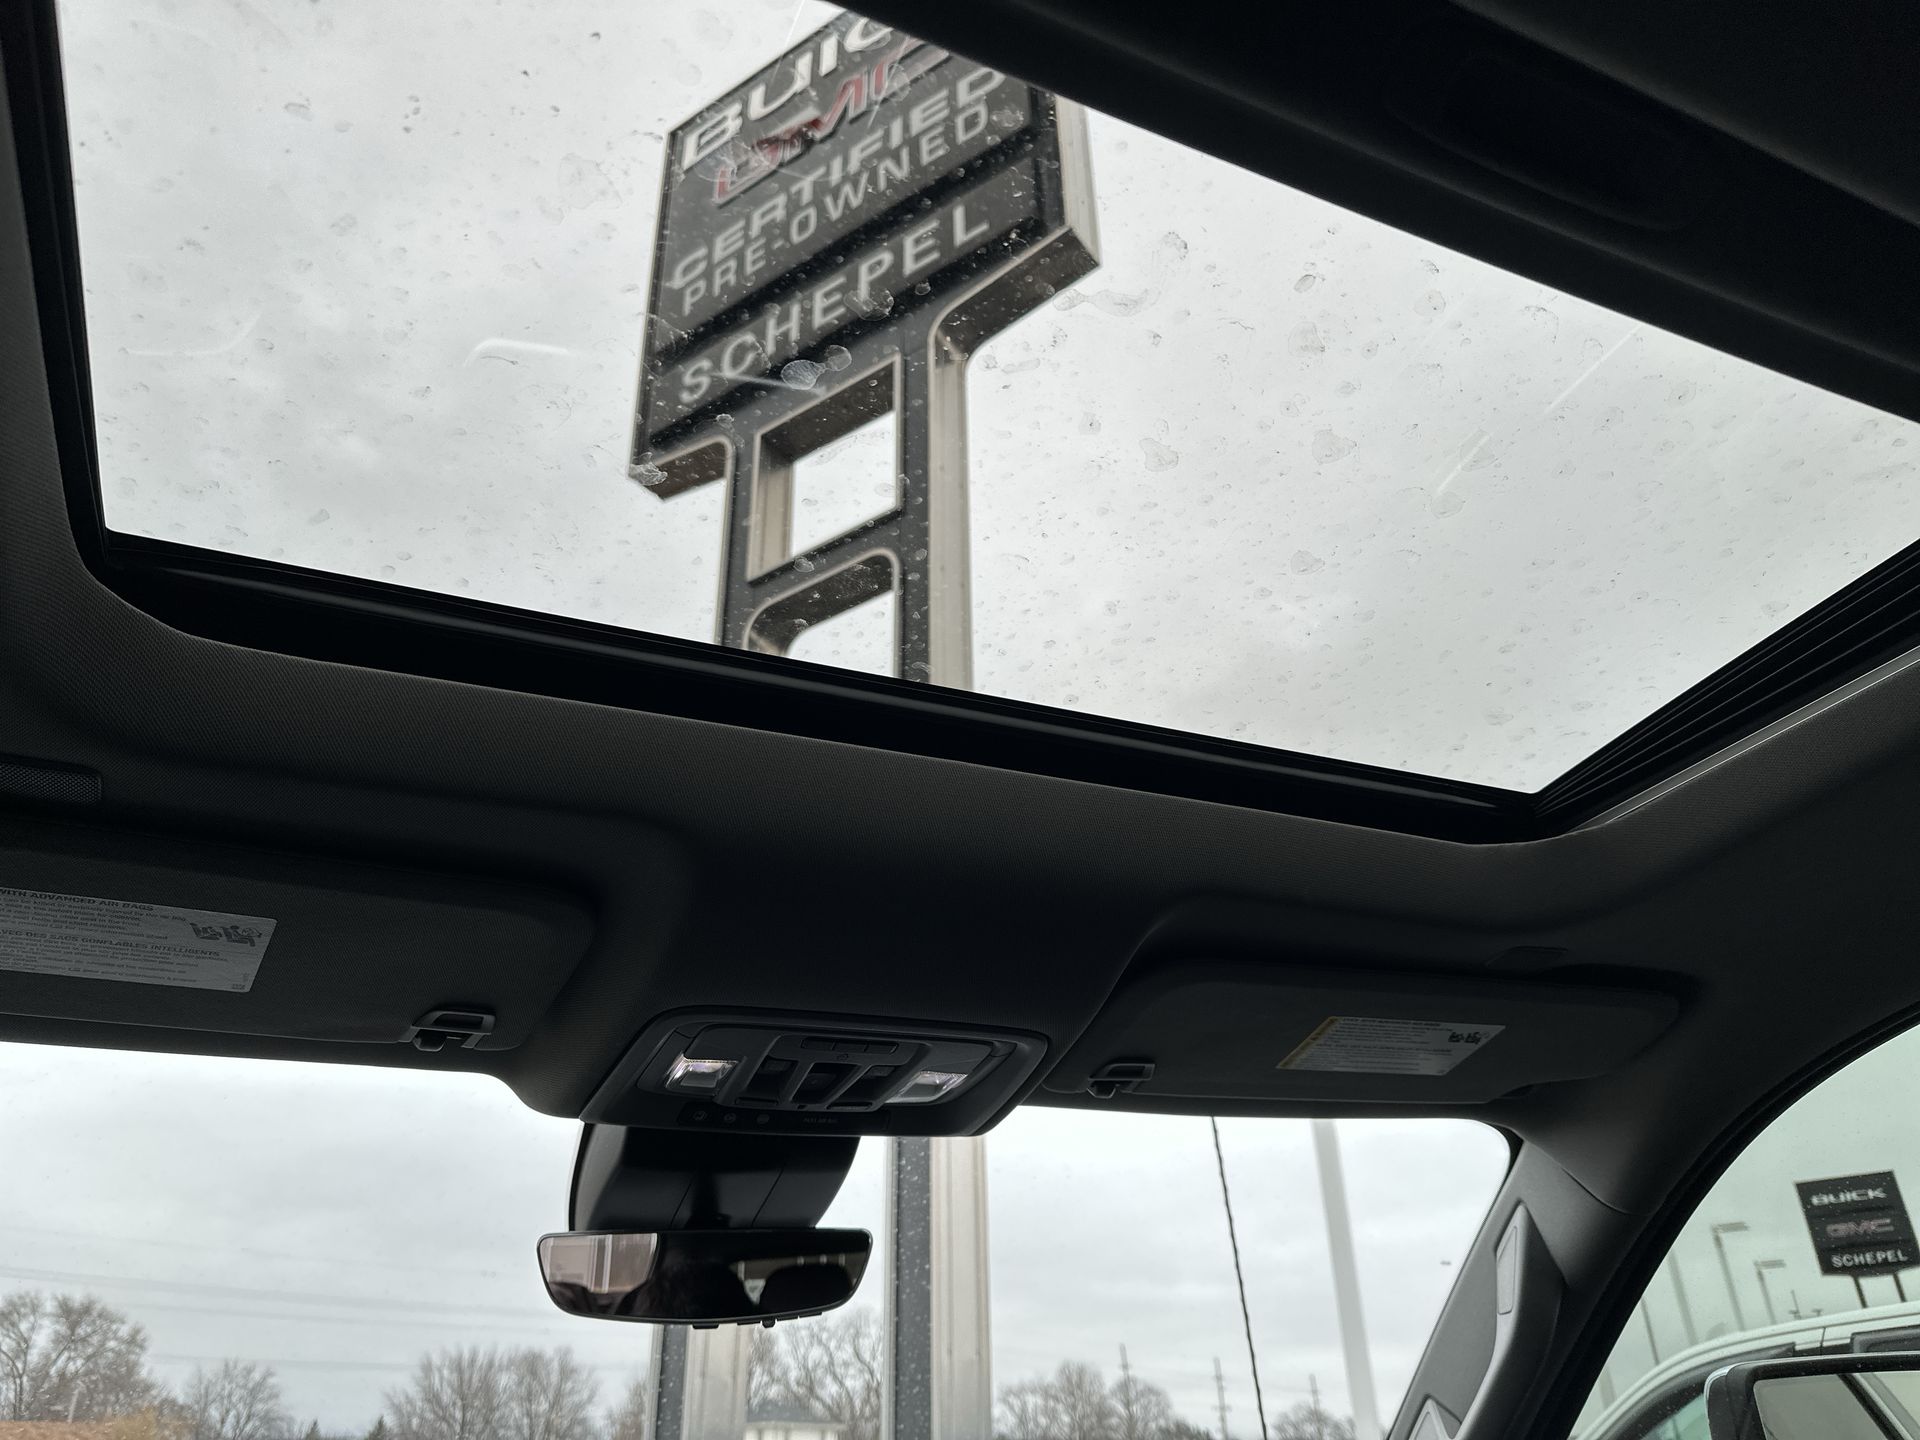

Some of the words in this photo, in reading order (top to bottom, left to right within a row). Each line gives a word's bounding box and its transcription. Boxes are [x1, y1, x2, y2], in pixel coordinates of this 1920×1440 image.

[683, 16, 894, 171] BUIC
[666, 65, 1007, 290] CERTIFIED
[682, 101, 989, 316] PRE-OWNED
[678, 204, 990, 403] SCHEPEL
[30, 892, 96, 904] ADVANCED
[122, 902, 154, 911] BAGS
[0, 929, 23, 937] VEC
[49, 933, 79, 942] SACS
[1811, 1187, 1887, 1206] BUICK
[1826, 1218, 1894, 1238] GMC
[1831, 1250, 1909, 1268] SCHEPEL
